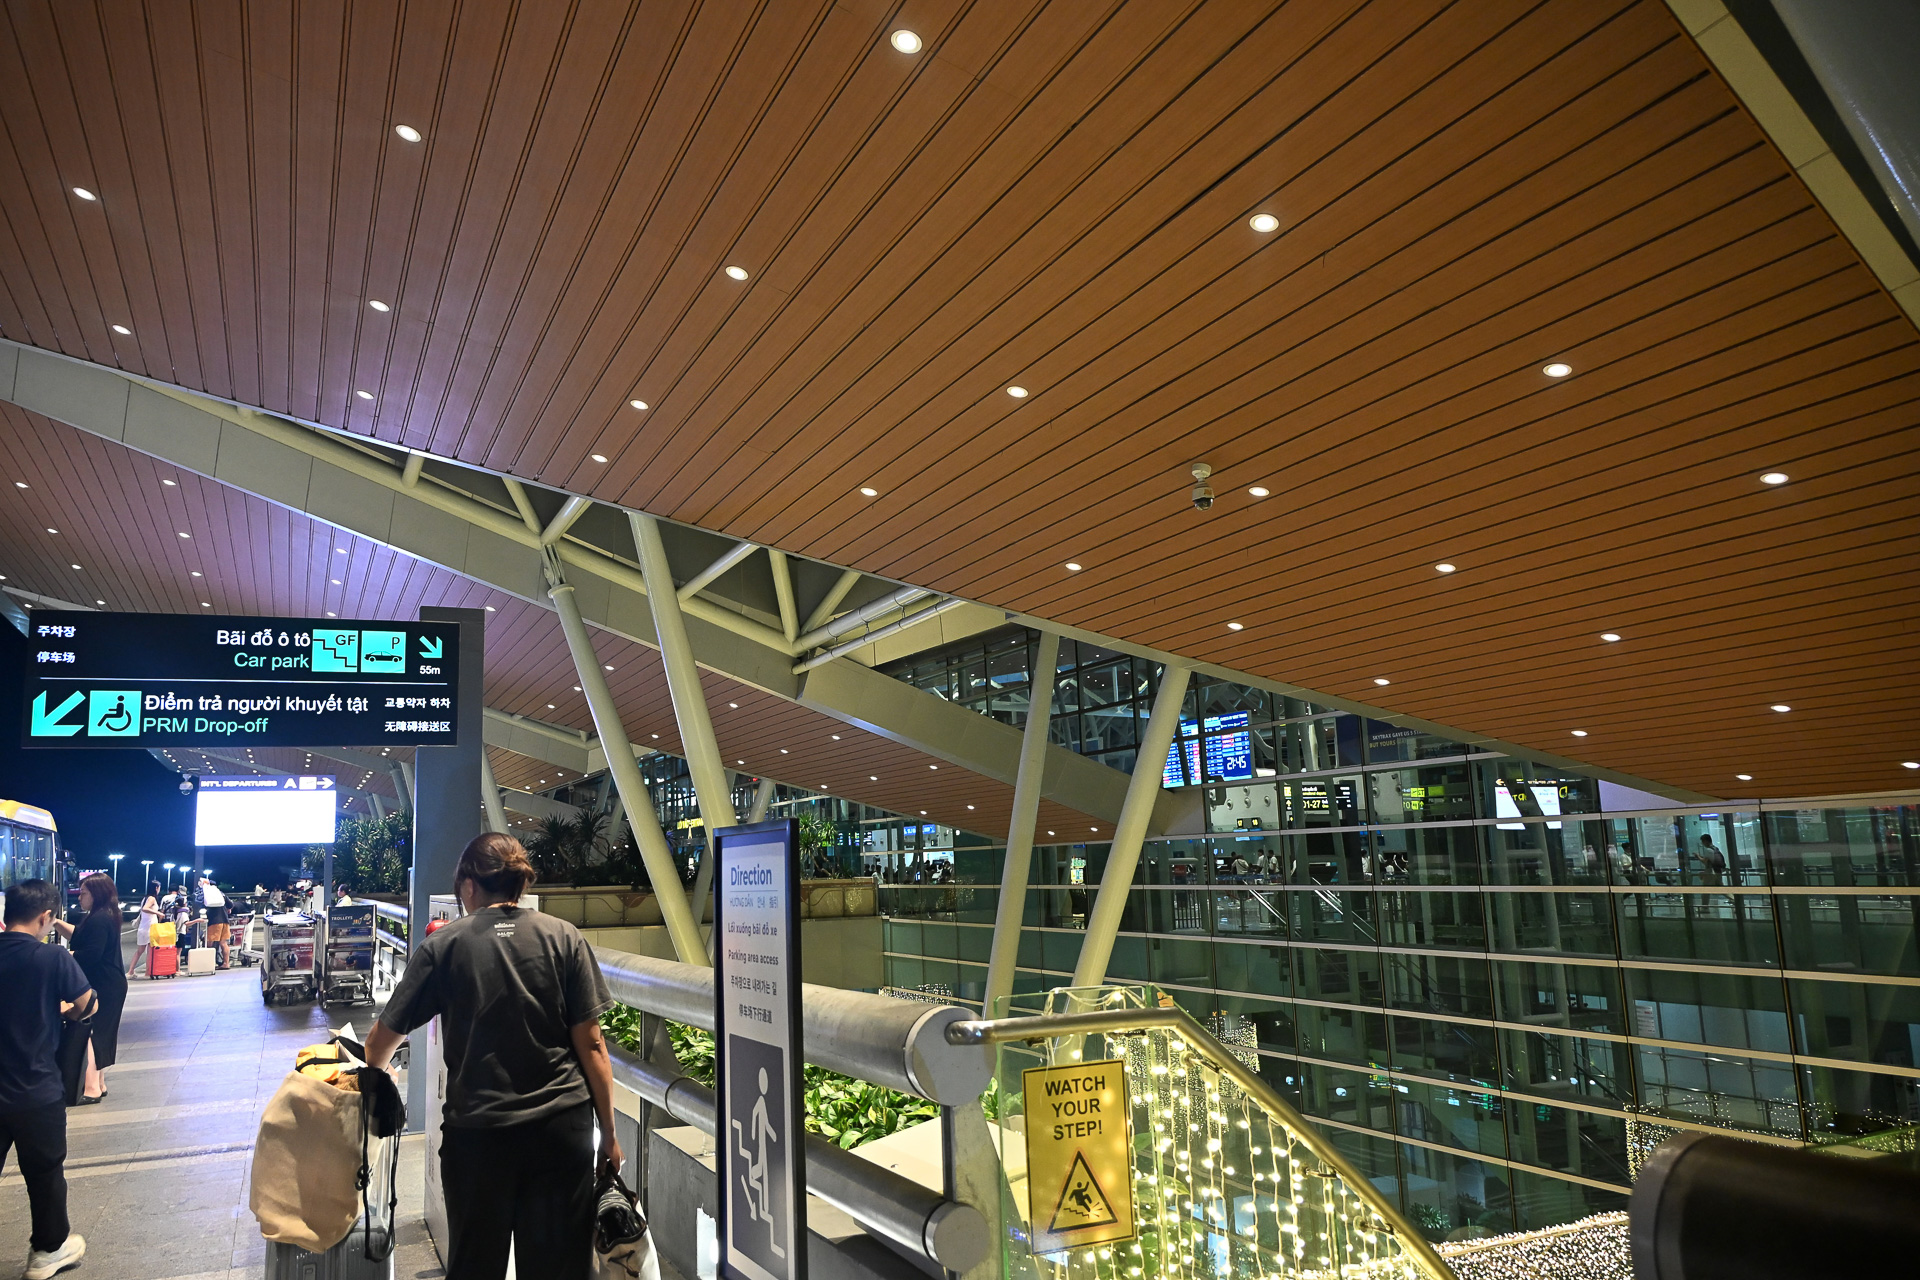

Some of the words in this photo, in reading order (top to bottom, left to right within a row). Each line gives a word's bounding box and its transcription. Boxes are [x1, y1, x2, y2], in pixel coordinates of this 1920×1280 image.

[38, 625, 76, 638] 주차장
[216, 629, 246, 645] Bãi
[250, 628, 273, 646] đỗ
[278, 631, 289, 646] ô
[293, 632, 311, 647] tô
[335, 634, 356, 646] GF
[391, 636, 401, 649] P
[36, 651, 76, 664] 停车场
[234, 652, 267, 667] Car
[271, 654, 310, 671] park
[419, 665, 441, 675] 55m
[144, 691, 194, 711] Điểm
[198, 694, 223, 711] trả
[227, 695, 281, 715] người
[285, 693, 343, 715] khuyết
[346, 696, 369, 714] tật
[430, 697, 451, 709] 하차
[143, 717, 189, 733] PRM
[194, 717, 269, 736] Drop-off
[222, 780, 278, 788] DEPARTURES
[283, 777, 298, 789] A
[731, 863, 772, 886] Direction
[770, 926, 778, 936] xe
[728, 949, 747, 964] Parking
[747, 953, 759, 963] area
[759, 954, 779, 966] access
[1045, 1075, 1106, 1097] WATCH
[1051, 1098, 1101, 1118] YOUR
[1053, 1120, 1103, 1141] STEP!
